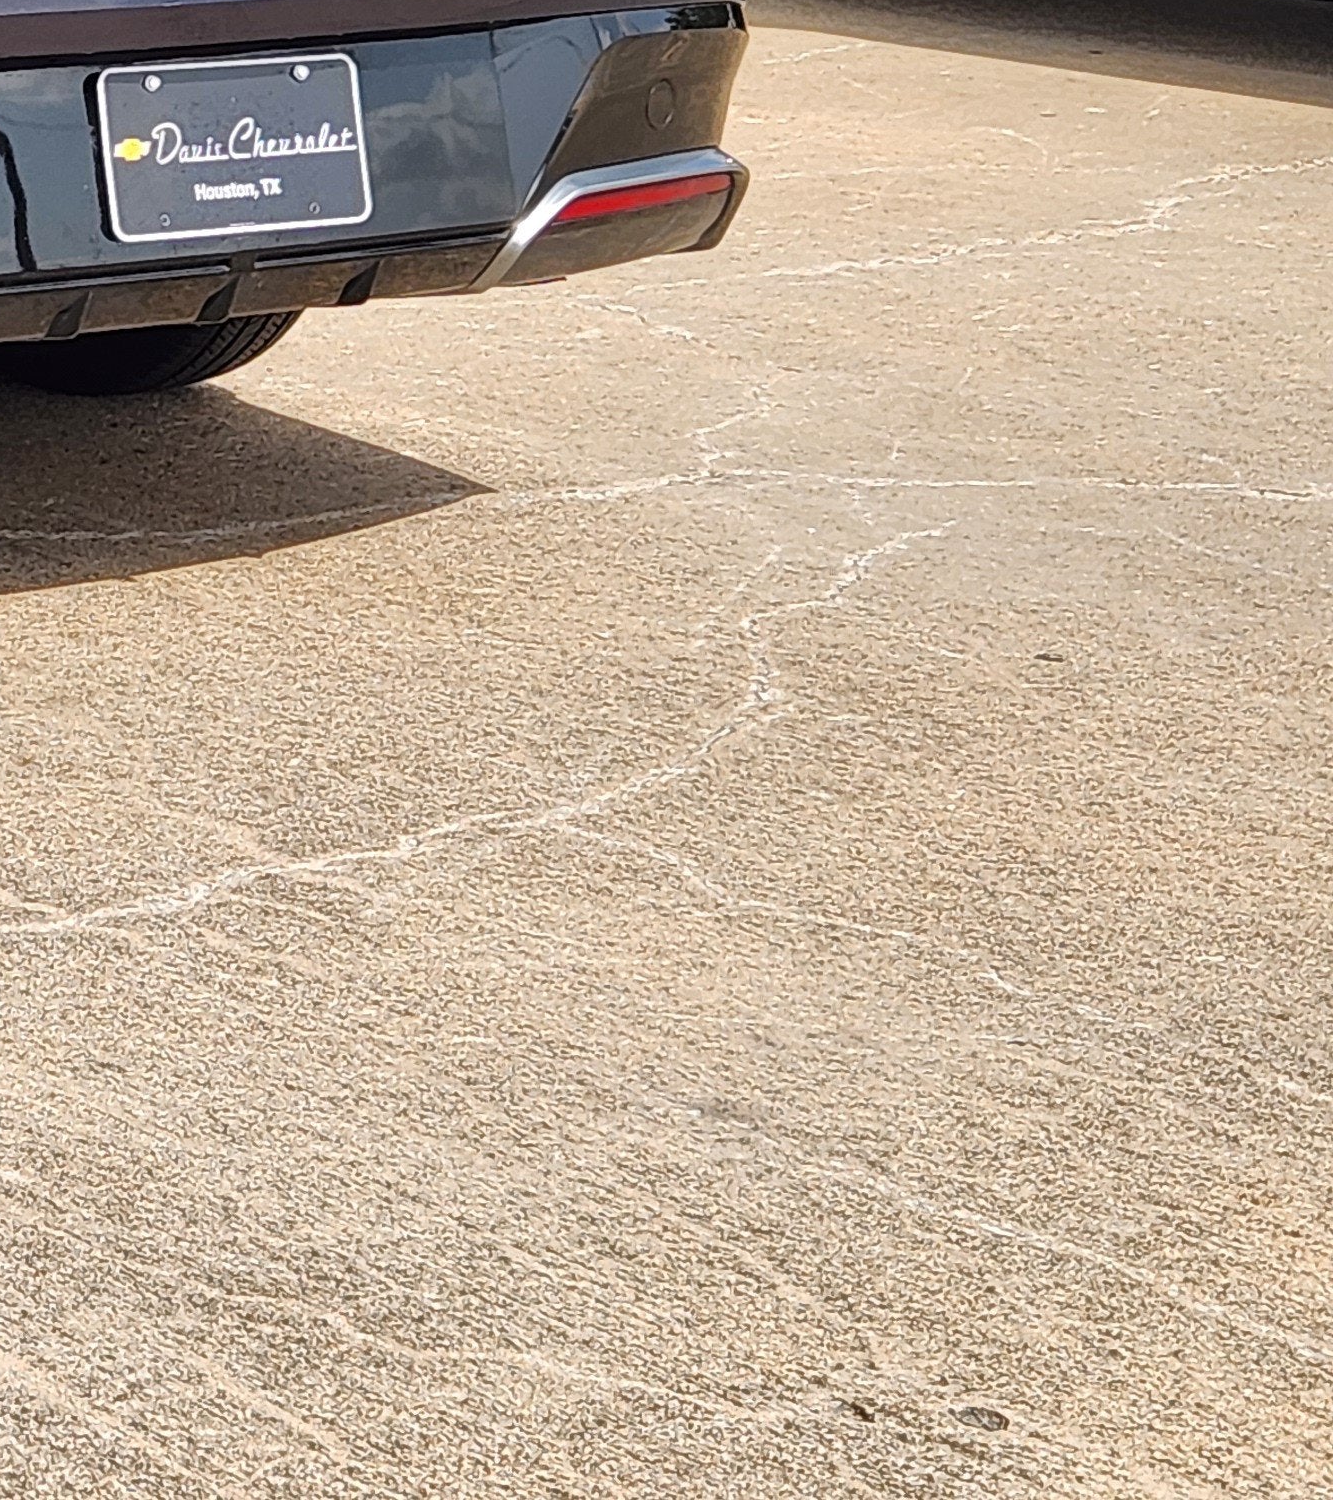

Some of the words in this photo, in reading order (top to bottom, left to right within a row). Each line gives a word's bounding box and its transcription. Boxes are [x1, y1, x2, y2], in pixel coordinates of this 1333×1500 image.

[151, 121, 229, 165] Davis
[227, 116, 358, 160] Chevrolet
[193, 181, 260, 201] Houston,
[259, 177, 283, 196] TX
